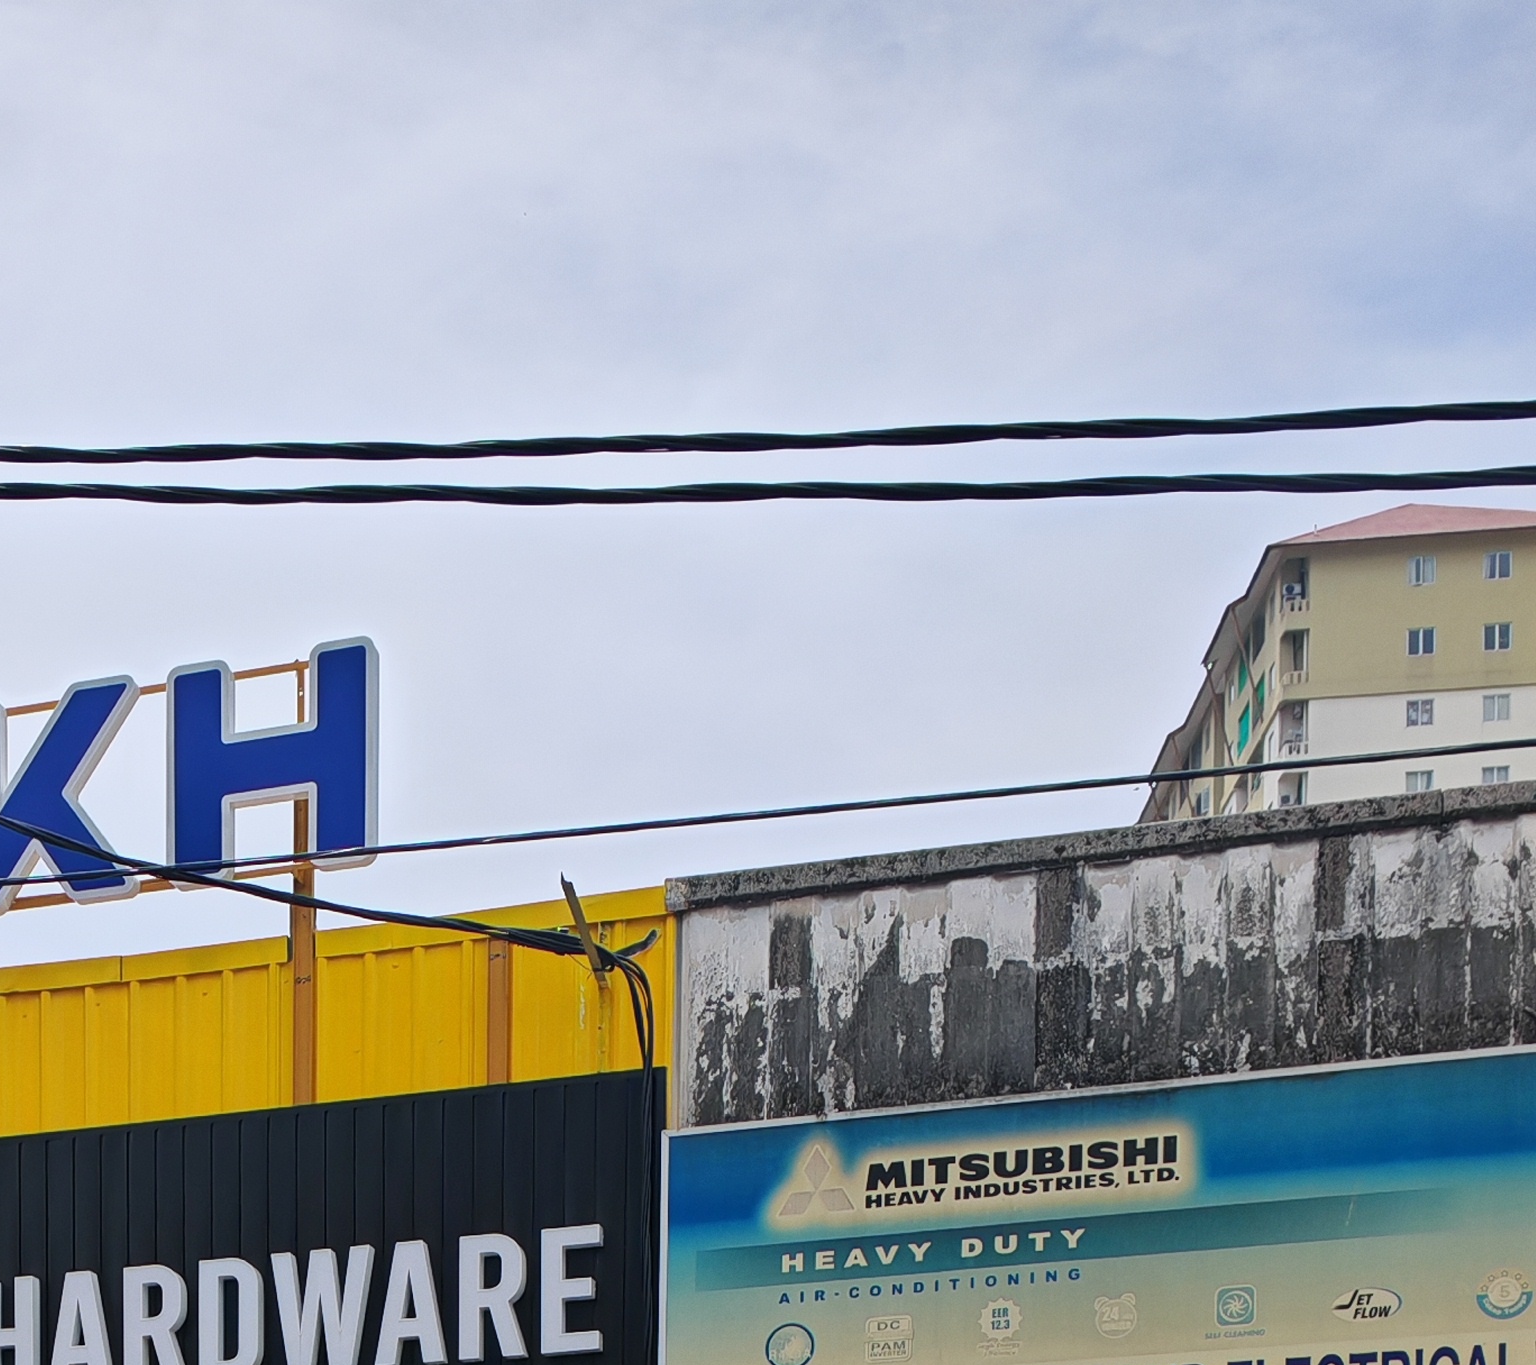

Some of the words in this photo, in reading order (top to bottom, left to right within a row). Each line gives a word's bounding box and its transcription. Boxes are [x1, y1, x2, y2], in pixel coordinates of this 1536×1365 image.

[865, 1135, 1178, 1191] MITSUBISHI
[865, 1188, 946, 1209] HEAVY
[954, 1173, 1121, 1200] INDUSTRIES,
[1127, 1167, 1180, 1185] LTD.
[780, 1241, 932, 1274] HEAVY
[961, 1227, 1088, 1260] DUTY
[779, 1268, 1083, 1304] AIR-CONDITIONING
[877, 1320, 901, 1331] DC
[1353, 1304, 1392, 1320] FLOW
[871, 1341, 906, 1351] PAM
